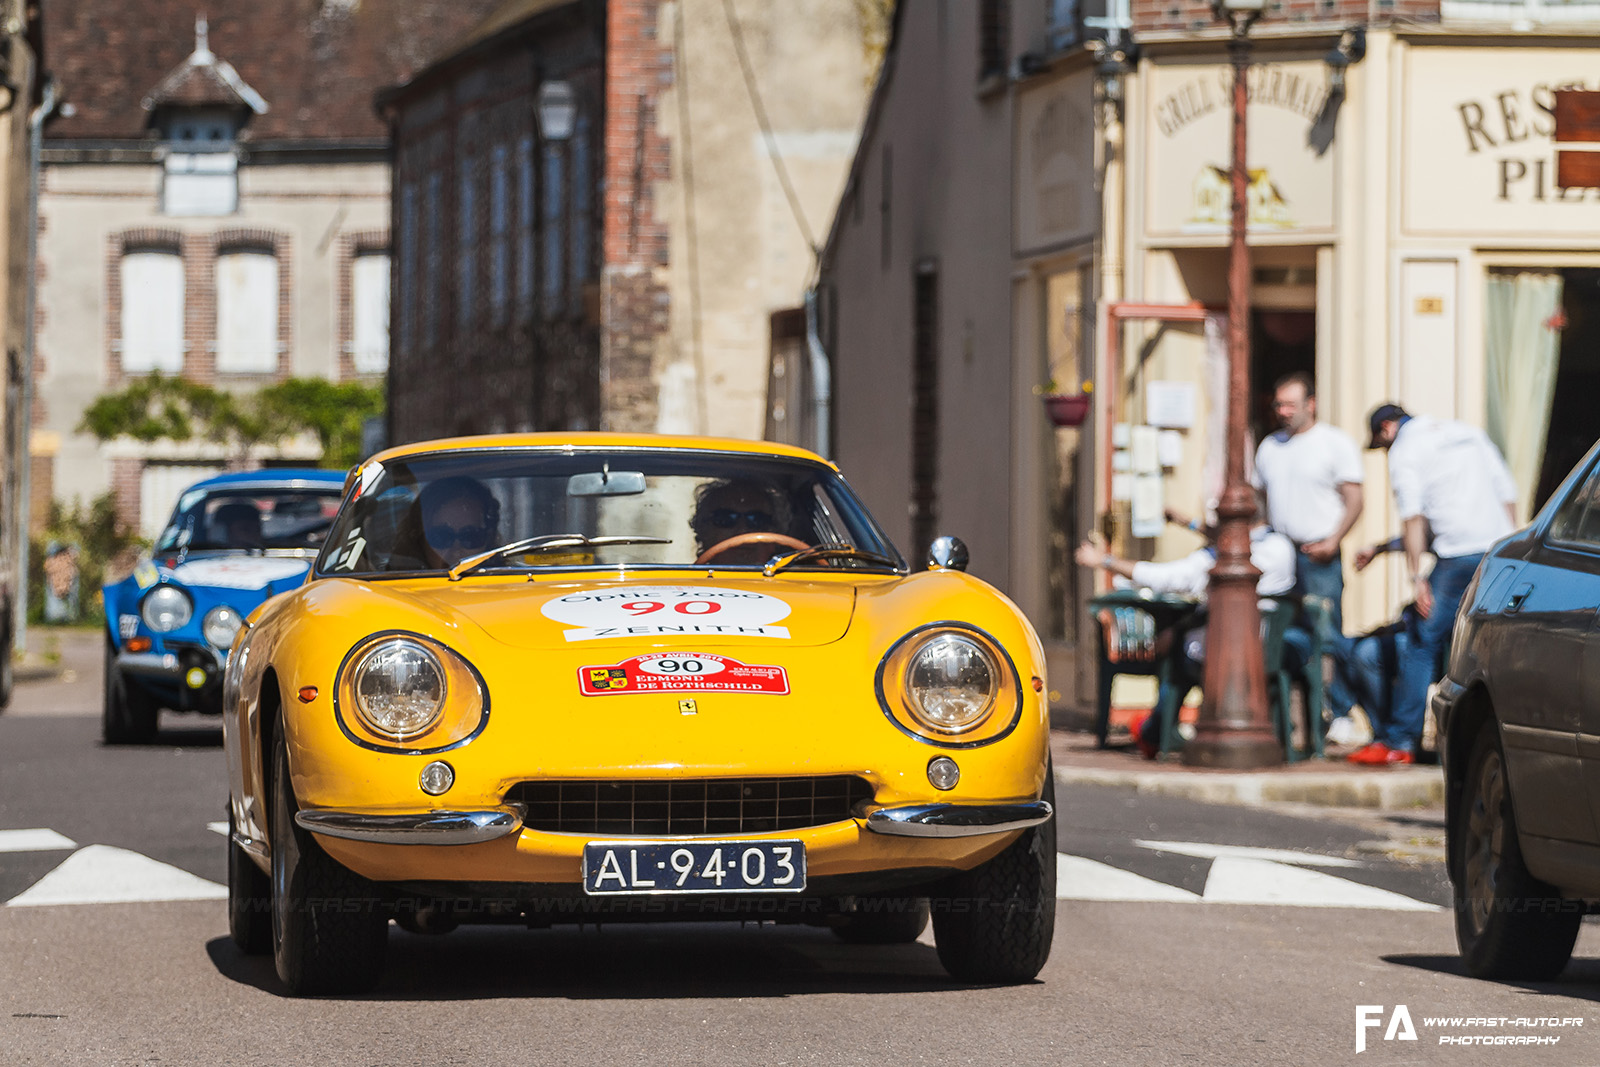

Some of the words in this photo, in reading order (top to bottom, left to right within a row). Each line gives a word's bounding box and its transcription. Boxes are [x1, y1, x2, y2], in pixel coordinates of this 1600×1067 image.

[1456, 81, 1586, 152] RES
[561, 591, 661, 604] Optic
[672, 591, 764, 600] 2000
[621, 601, 722, 617] 90
[595, 625, 766, 637] ZENITH
[657, 659, 704, 673] 90
[635, 674, 705, 682] EDMOND
[637, 682, 658, 690] DE
[662, 681, 763, 690] ROTHSCHILD
